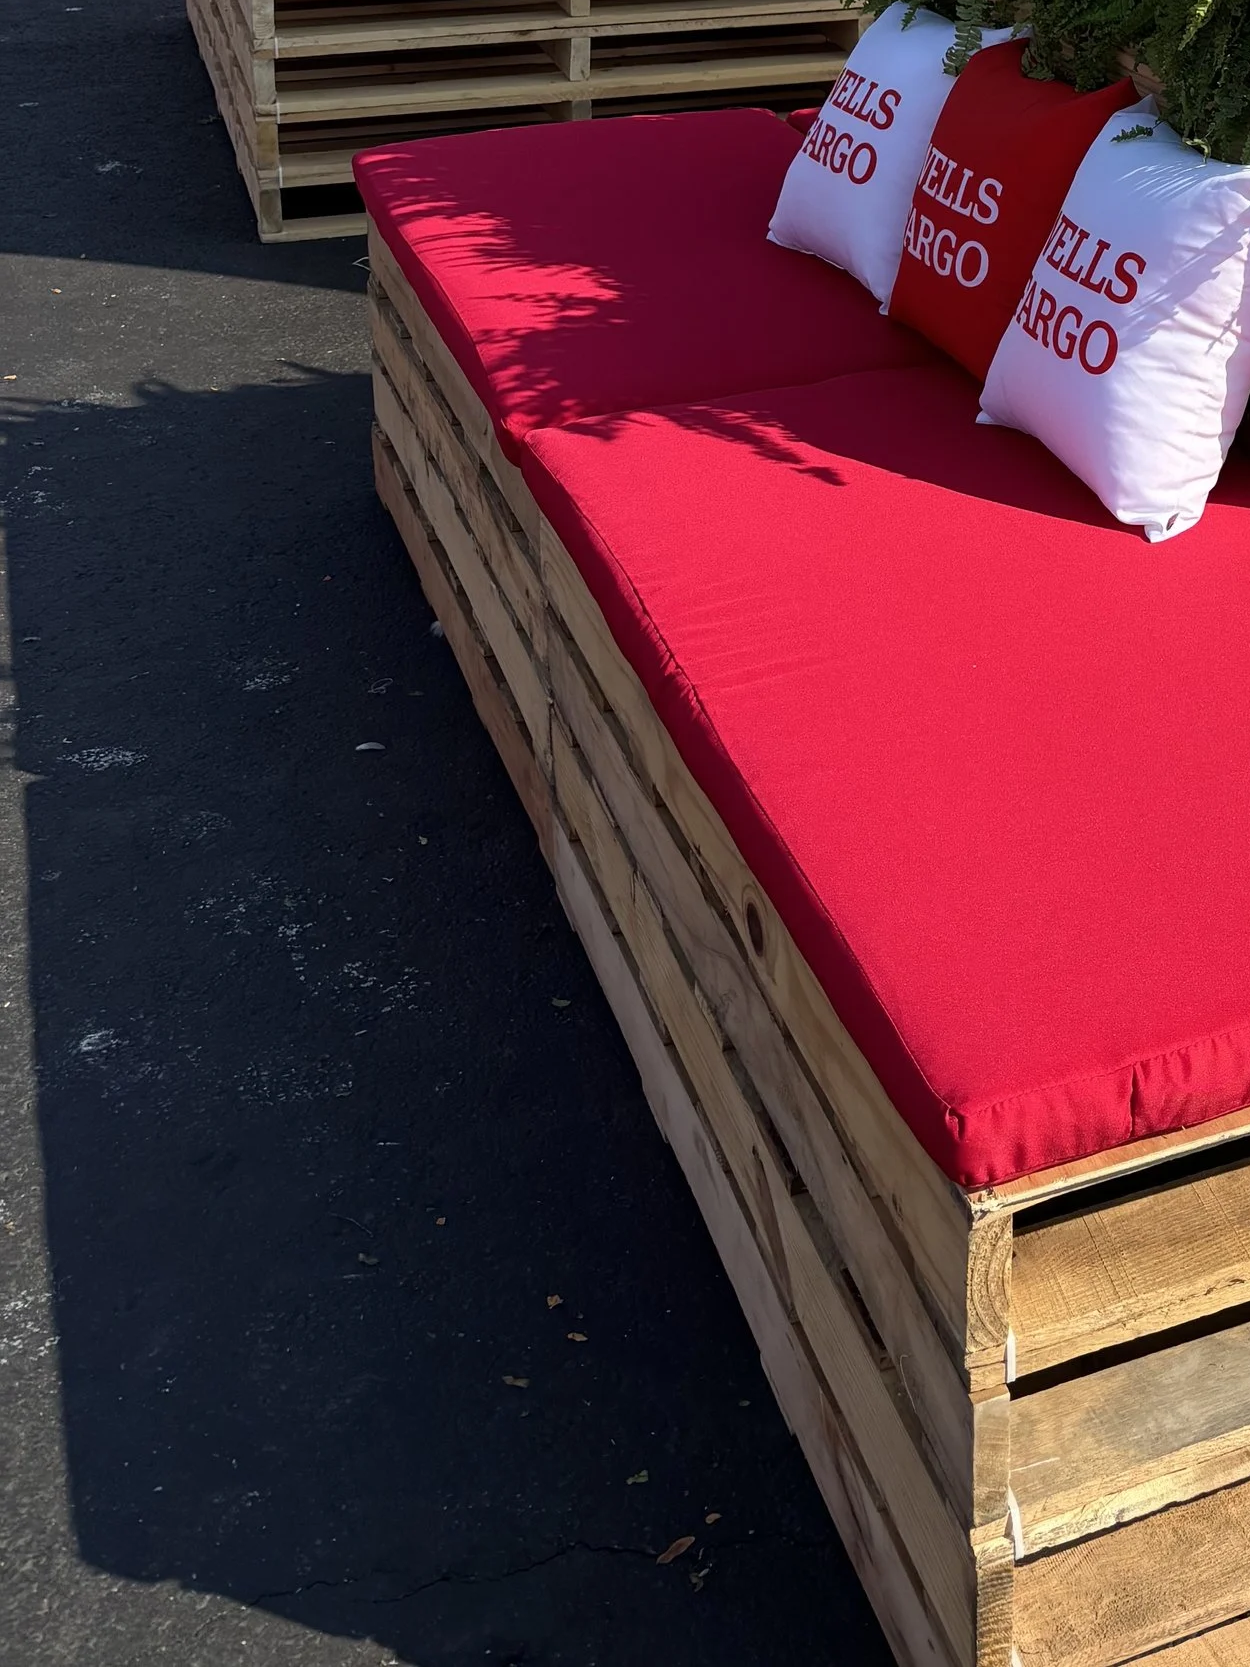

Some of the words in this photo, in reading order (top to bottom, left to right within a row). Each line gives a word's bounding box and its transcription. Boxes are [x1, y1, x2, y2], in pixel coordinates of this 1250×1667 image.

[829, 67, 902, 130] ELLS
[802, 118, 878, 185] ARGO
[918, 143, 1003, 225] ELLS
[904, 207, 989, 288] ARGO
[1043, 211, 1147, 305] ELLS
[1014, 276, 1119, 376] ARGO
